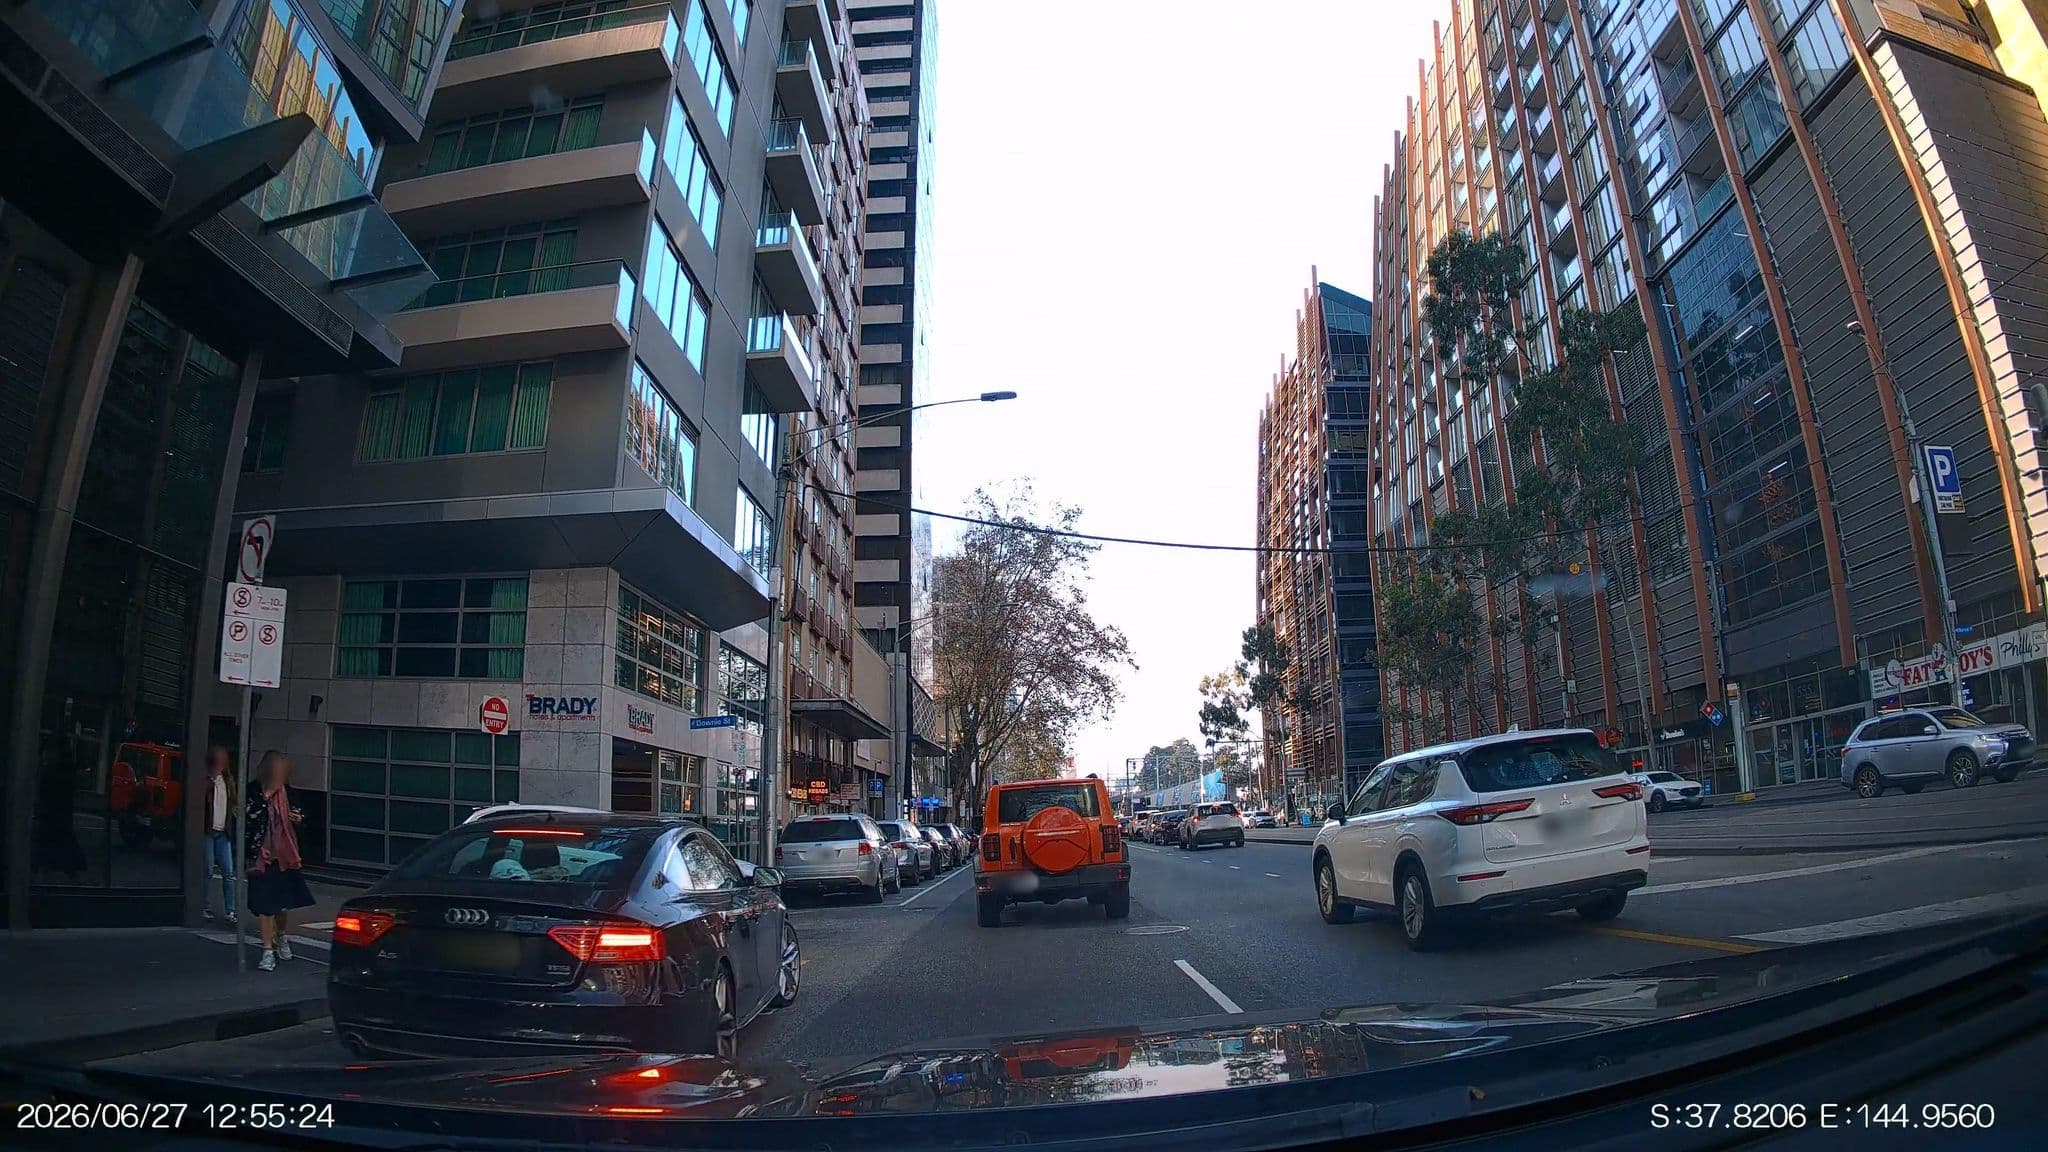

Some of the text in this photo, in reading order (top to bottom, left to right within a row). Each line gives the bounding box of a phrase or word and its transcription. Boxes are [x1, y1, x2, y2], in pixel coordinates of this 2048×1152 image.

[1933, 454, 1951, 487] P
[1904, 663, 1931, 686] FAT
[1959, 646, 1994, 673] OY'S
[491, 703, 500, 711] NO
[529, 697, 597, 715] BRADY
[485, 719, 504, 729] ENTRY
